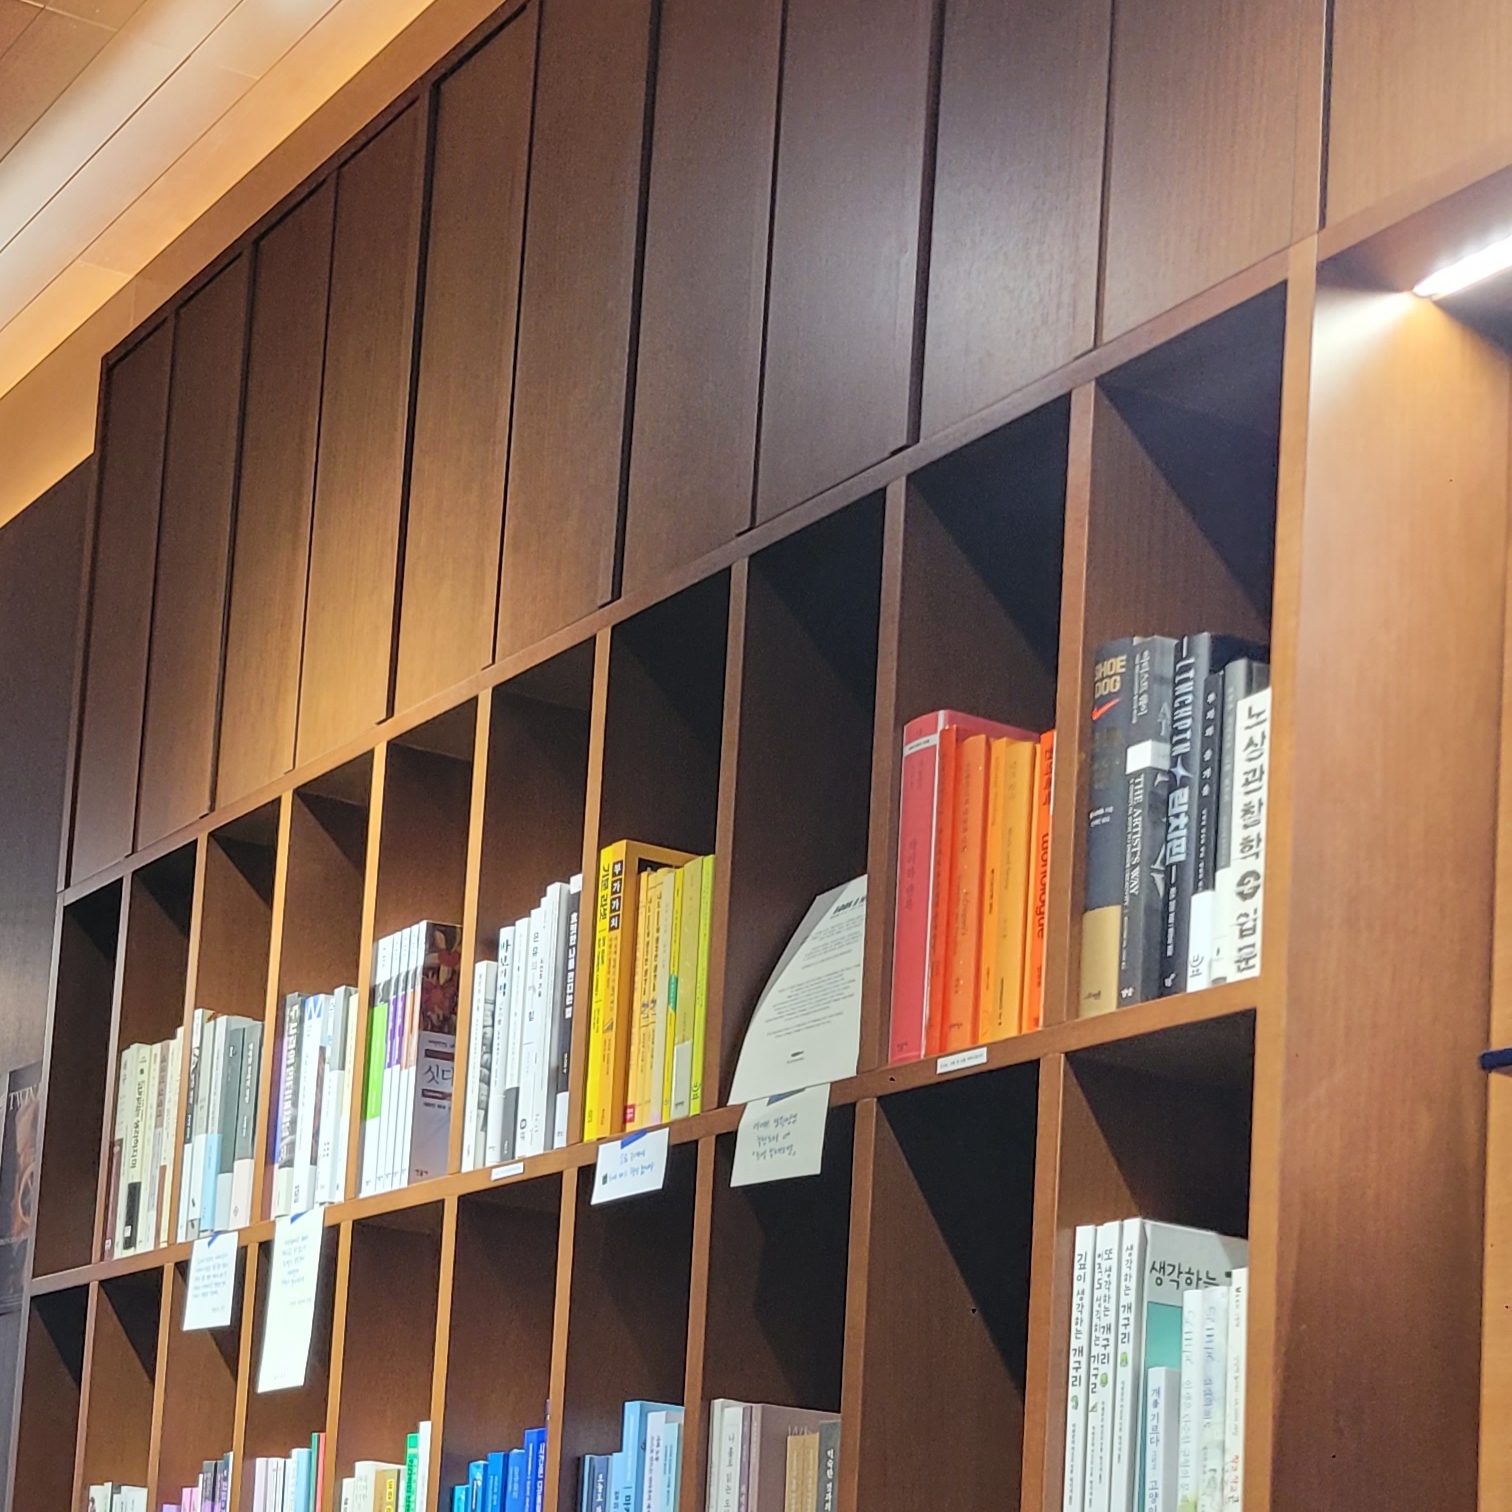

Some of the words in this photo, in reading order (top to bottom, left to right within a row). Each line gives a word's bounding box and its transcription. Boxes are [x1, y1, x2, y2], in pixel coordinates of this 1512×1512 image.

[1094, 675, 1121, 699] DOG
[1095, 654, 1127, 681] SHOE
[1171, 657, 1195, 757] LINCHPIN
[1134, 773, 1145, 804] THE
[1131, 807, 1143, 864] ARTIST'S
[1165, 785, 1190, 867] 린치핀
[609, 861, 623, 930] 부가가치
[1129, 866, 1140, 896] WAY
[1075, 1251, 1088, 1283] 깊이
[1103, 1248, 1113, 1261] 또
[1122, 1243, 1134, 1297] 생각하는
[1149, 1259, 1221, 1292] 생각하는
[1102, 1265, 1112, 1318] 생각하는
[1074, 1288, 1085, 1340] 생각하는
[1120, 1301, 1133, 1345] 개구리
[1100, 1323, 1112, 1365] 개구리
[1071, 1345, 1084, 1387] 개구리
[1150, 1386, 1161, 1410] 개를
[1149, 1412, 1160, 1448] 기르다
